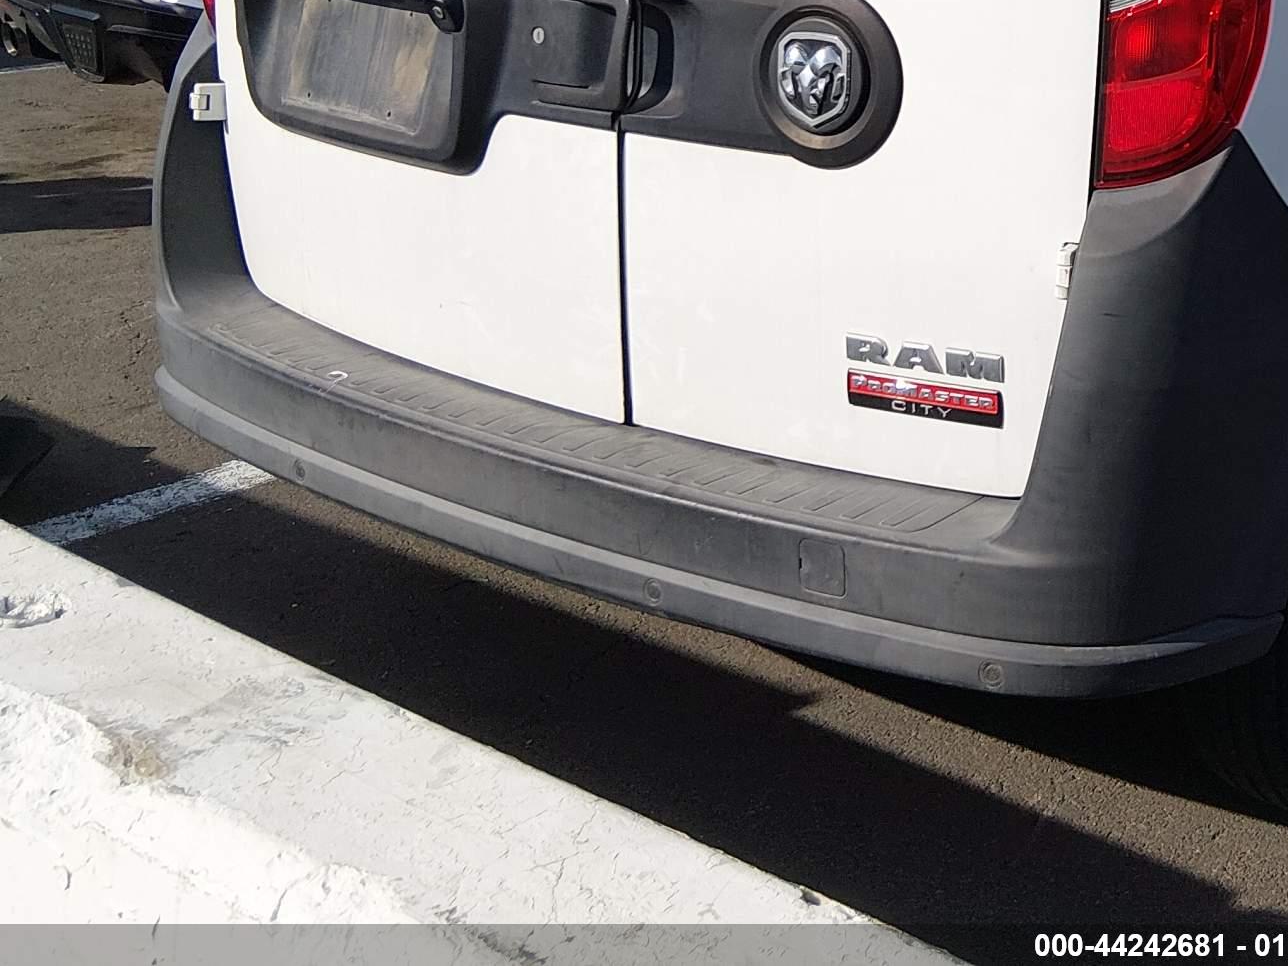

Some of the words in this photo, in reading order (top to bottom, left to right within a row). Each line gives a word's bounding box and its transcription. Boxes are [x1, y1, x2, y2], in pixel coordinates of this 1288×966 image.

[846, 332, 1004, 382] RAM
[851, 375, 994, 409] PROMASTER
[891, 400, 952, 418] CITY
